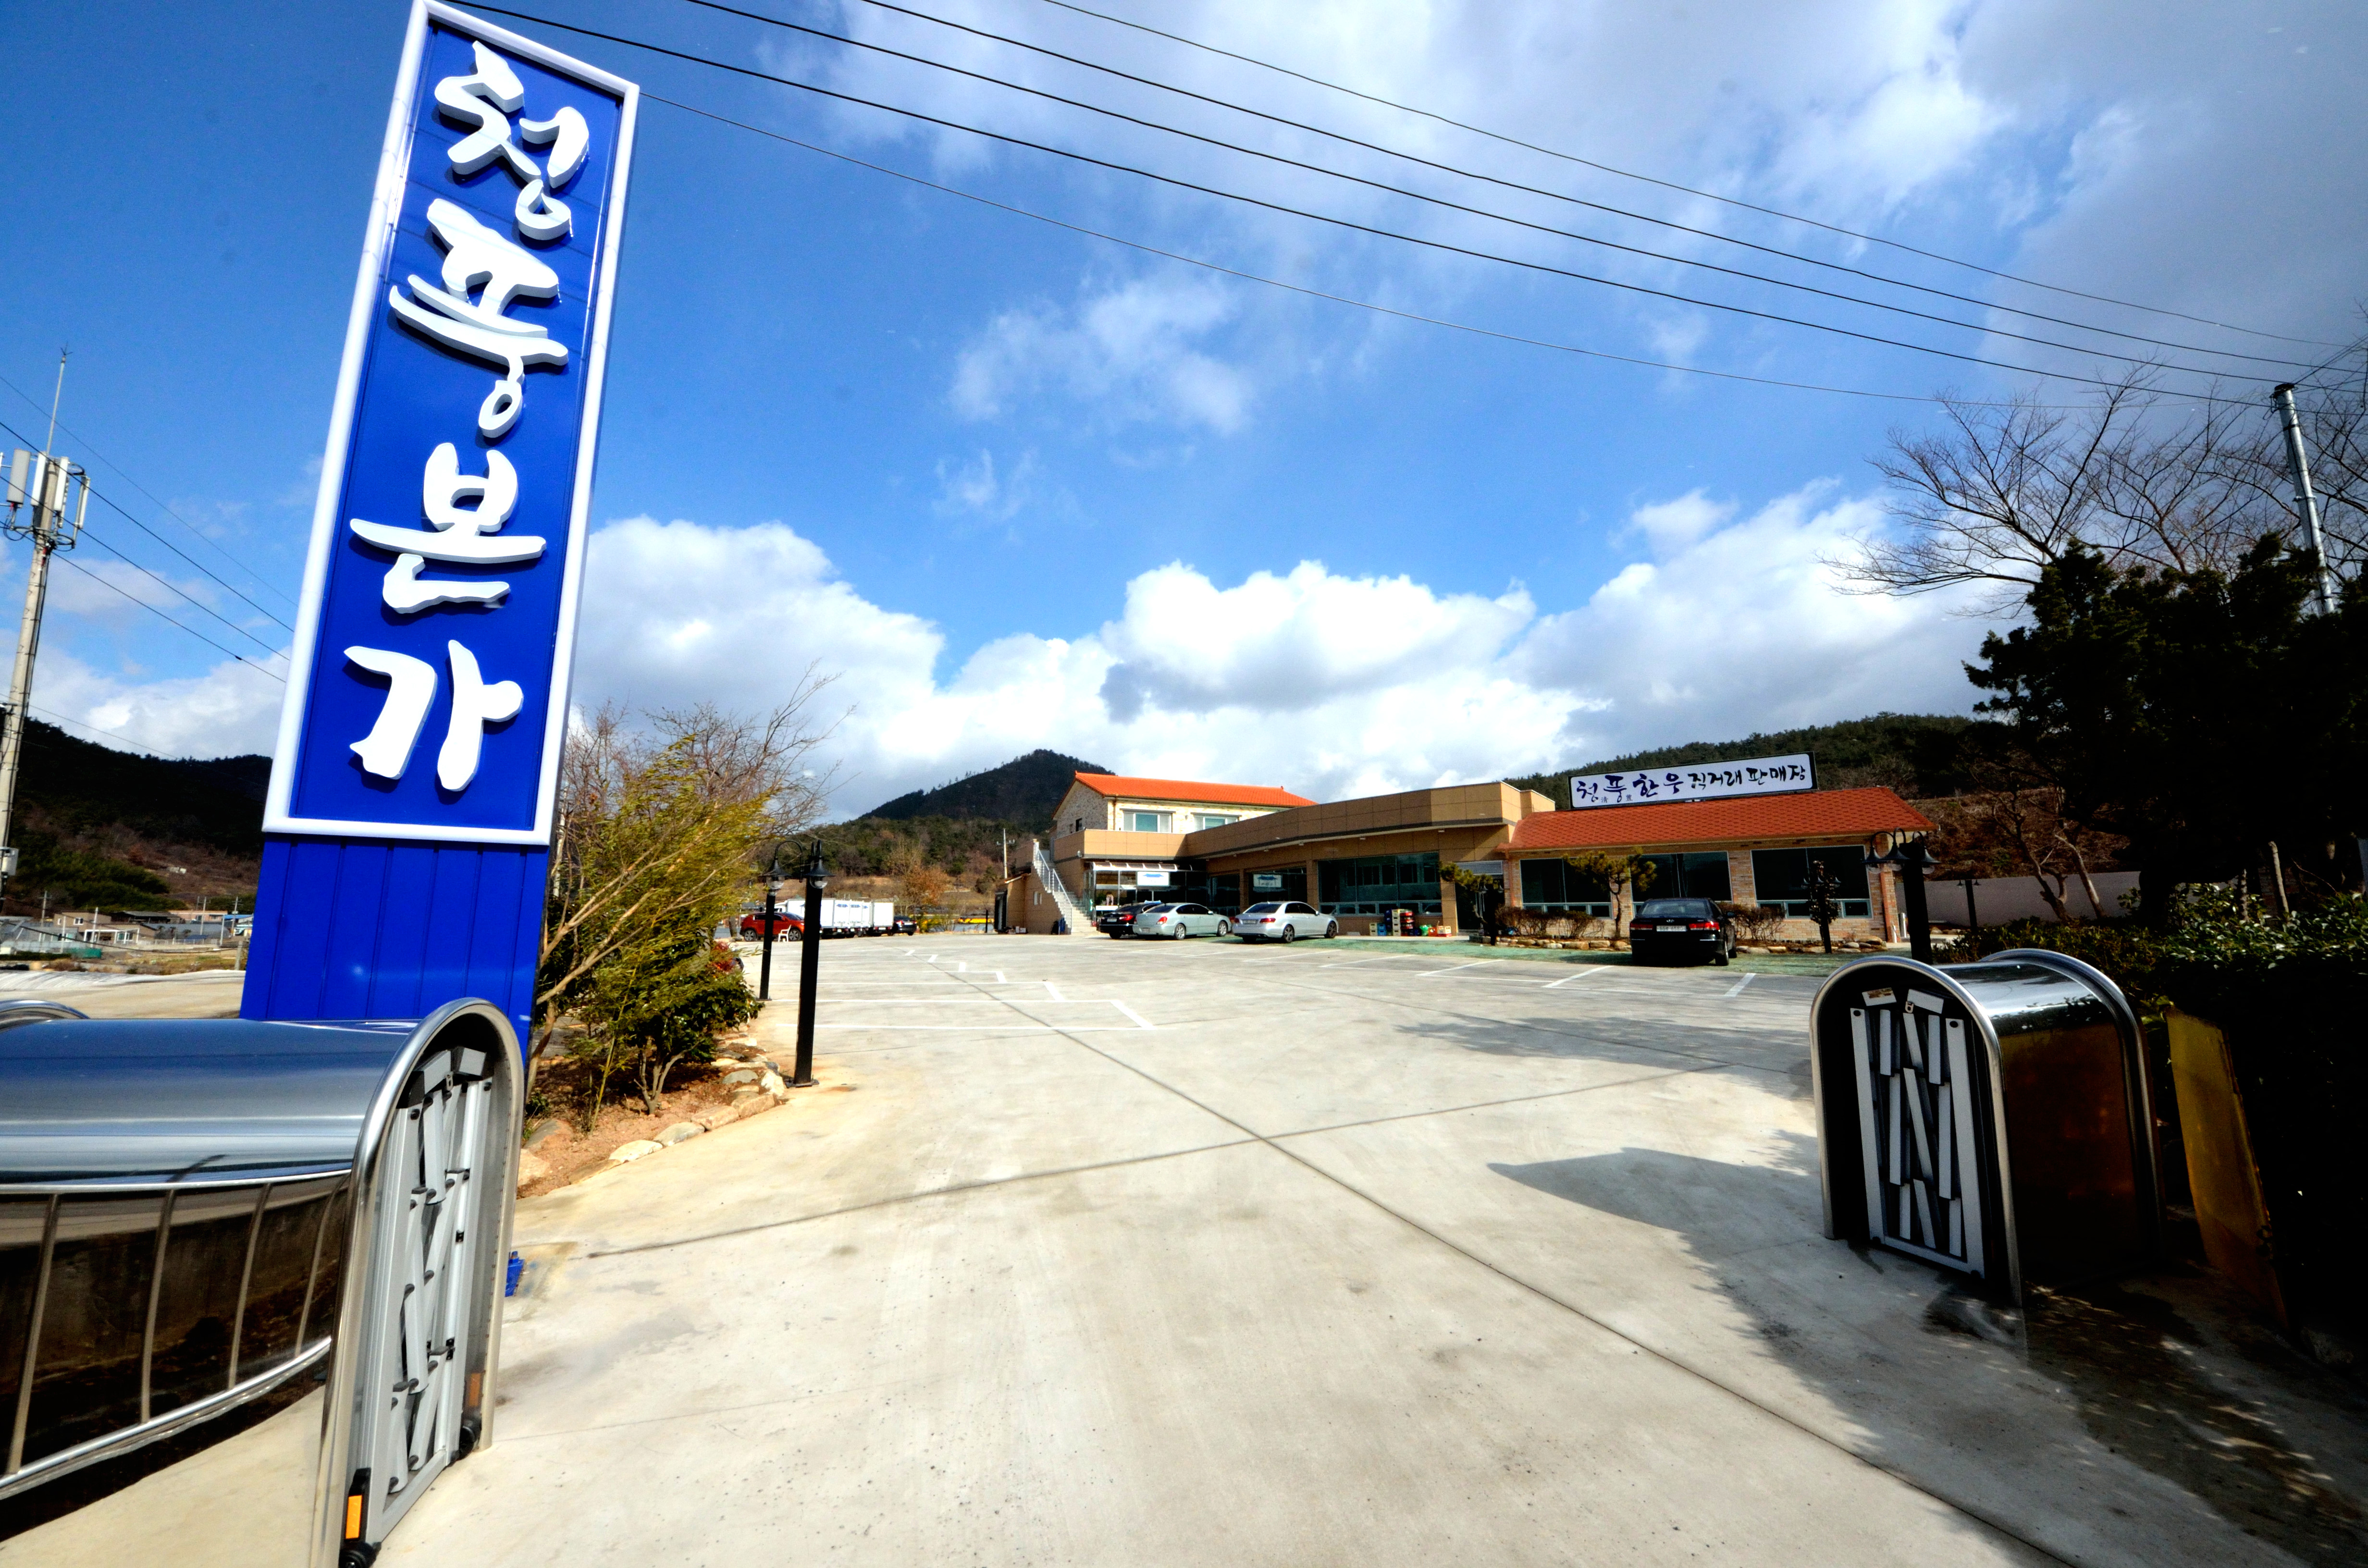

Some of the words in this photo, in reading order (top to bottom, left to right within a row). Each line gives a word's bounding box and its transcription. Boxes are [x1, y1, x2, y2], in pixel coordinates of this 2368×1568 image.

[343, 41, 589, 792] 청풍본가
[1688, 770, 1742, 790] 직거래
[1746, 765, 1806, 785] 판매장
